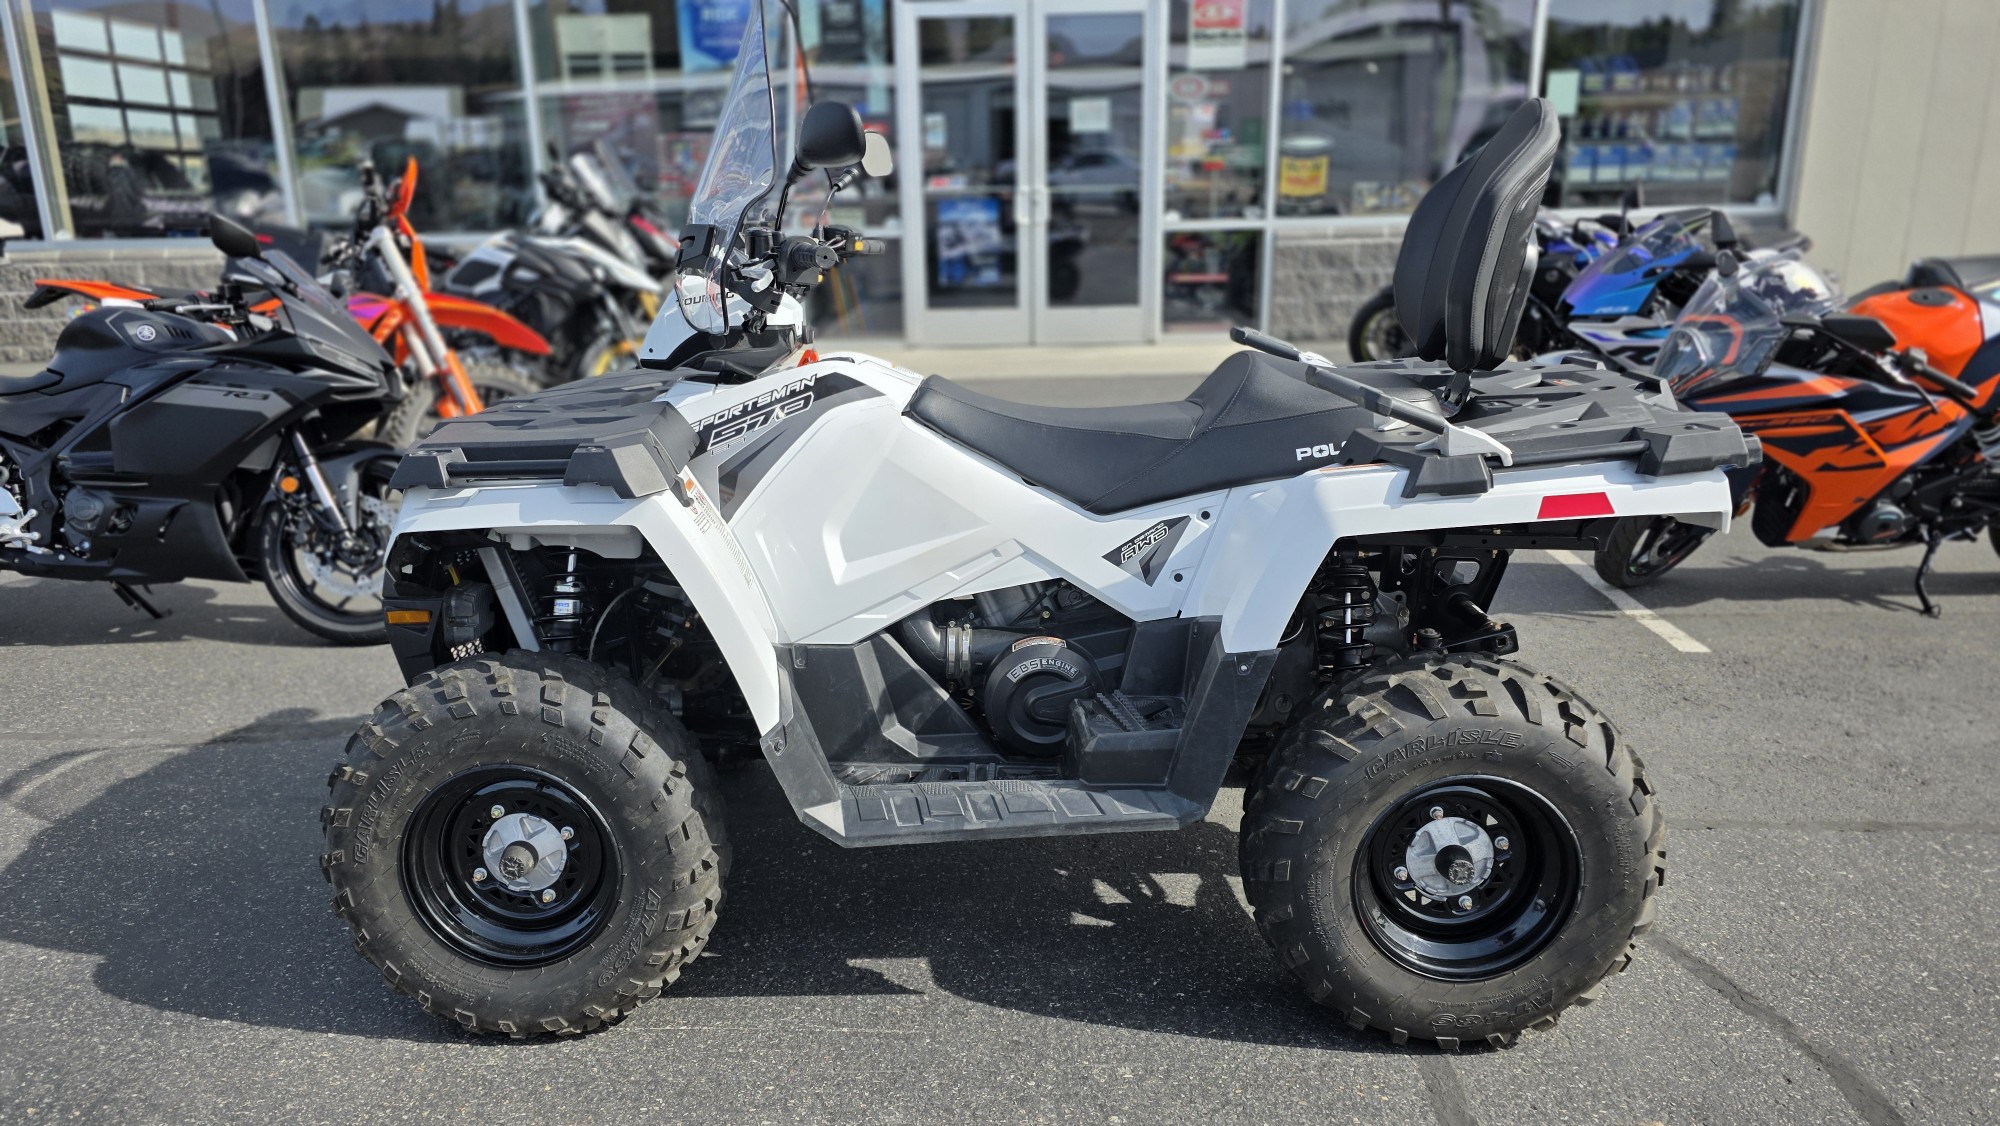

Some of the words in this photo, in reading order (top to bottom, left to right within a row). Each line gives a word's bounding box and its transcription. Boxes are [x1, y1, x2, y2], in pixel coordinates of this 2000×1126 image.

[691, 373, 818, 433] SPORTSMAN
[1121, 525, 1169, 564] AWD
[1010, 660, 1039, 680] EBS
[1041, 658, 1077, 675] ENGINE
[1364, 728, 1523, 780] CARLISLE
[354, 740, 431, 865] CARLISLE
